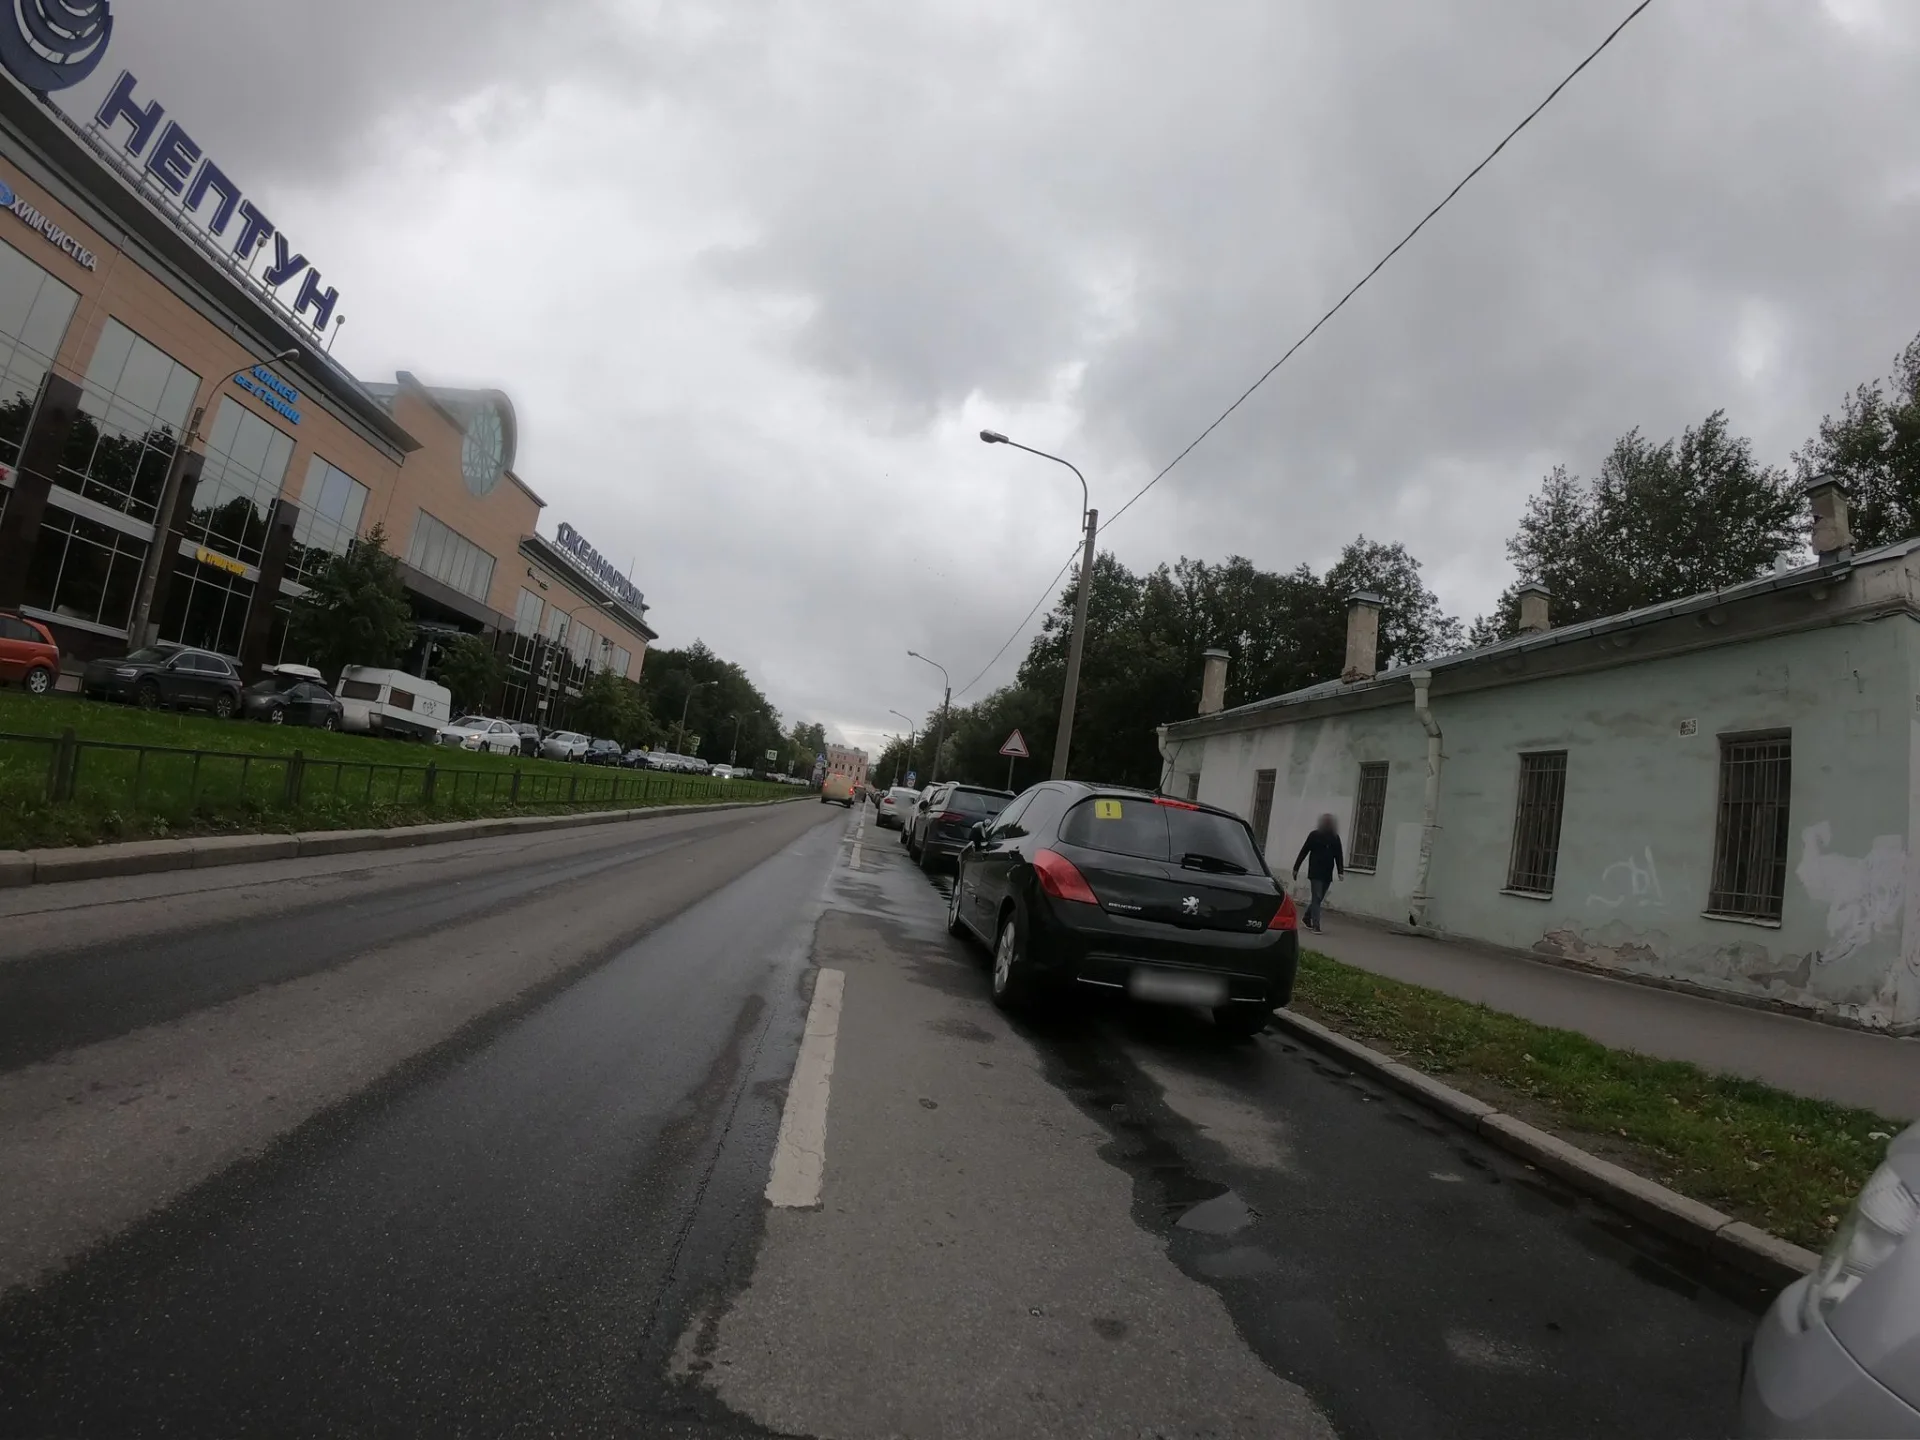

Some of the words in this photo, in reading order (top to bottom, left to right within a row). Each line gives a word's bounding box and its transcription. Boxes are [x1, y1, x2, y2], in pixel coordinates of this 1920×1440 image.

[9, 194, 98, 272] ХИМЧИСТКА
[94, 69, 339, 332] НЕПТУН
[558, 521, 645, 610] ОКЕАНАРИУМ
